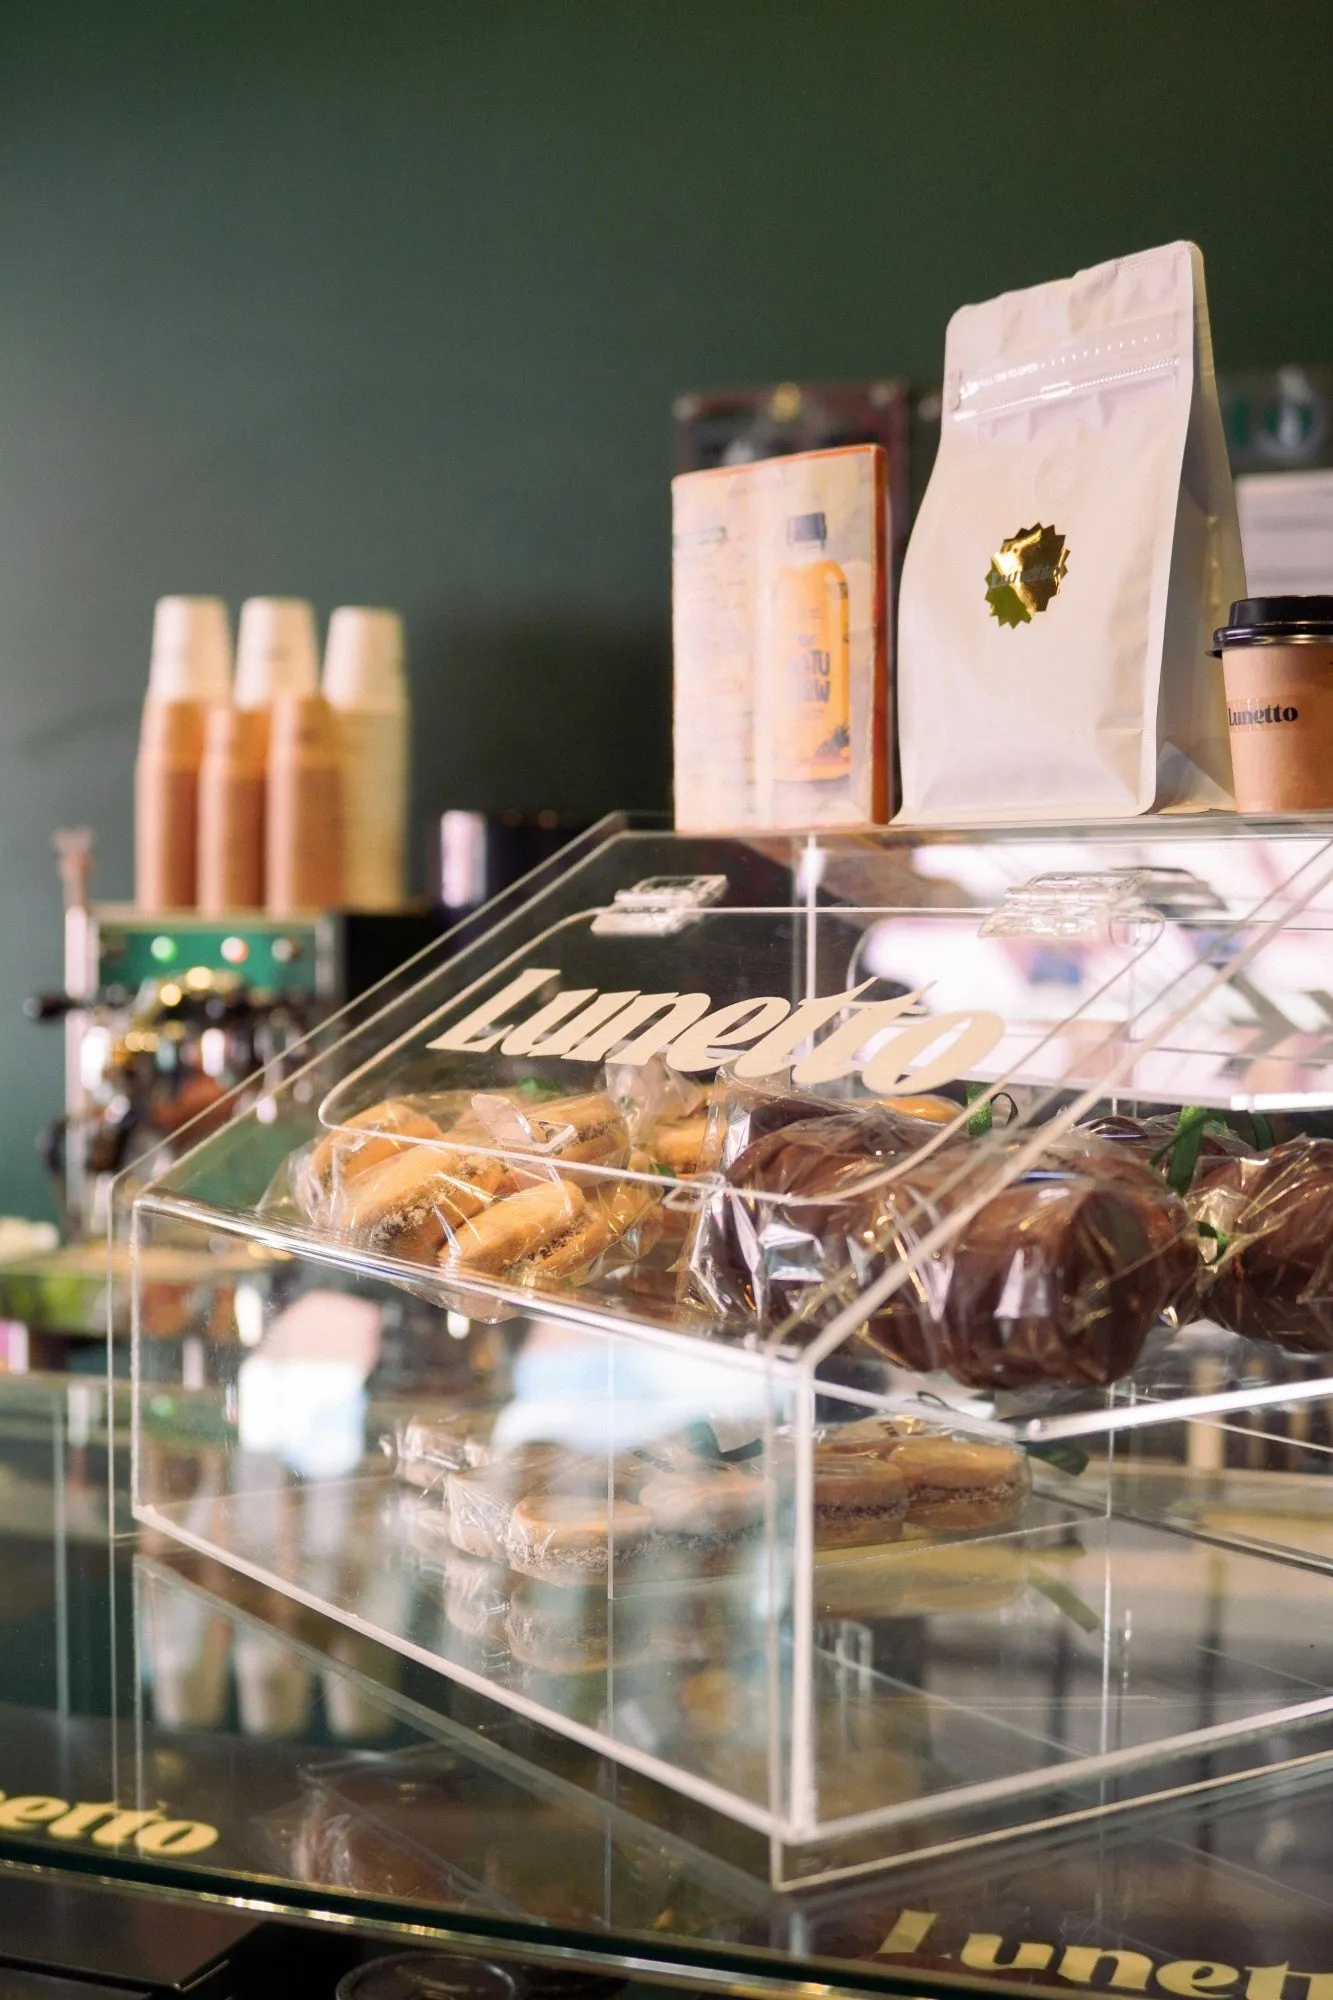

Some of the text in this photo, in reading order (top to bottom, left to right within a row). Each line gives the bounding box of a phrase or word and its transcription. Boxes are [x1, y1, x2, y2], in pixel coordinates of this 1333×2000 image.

[1228, 703, 1299, 727] Lunetto
[425, 967, 1005, 1095] Lunetto
[0, 1789, 219, 1856] etto
